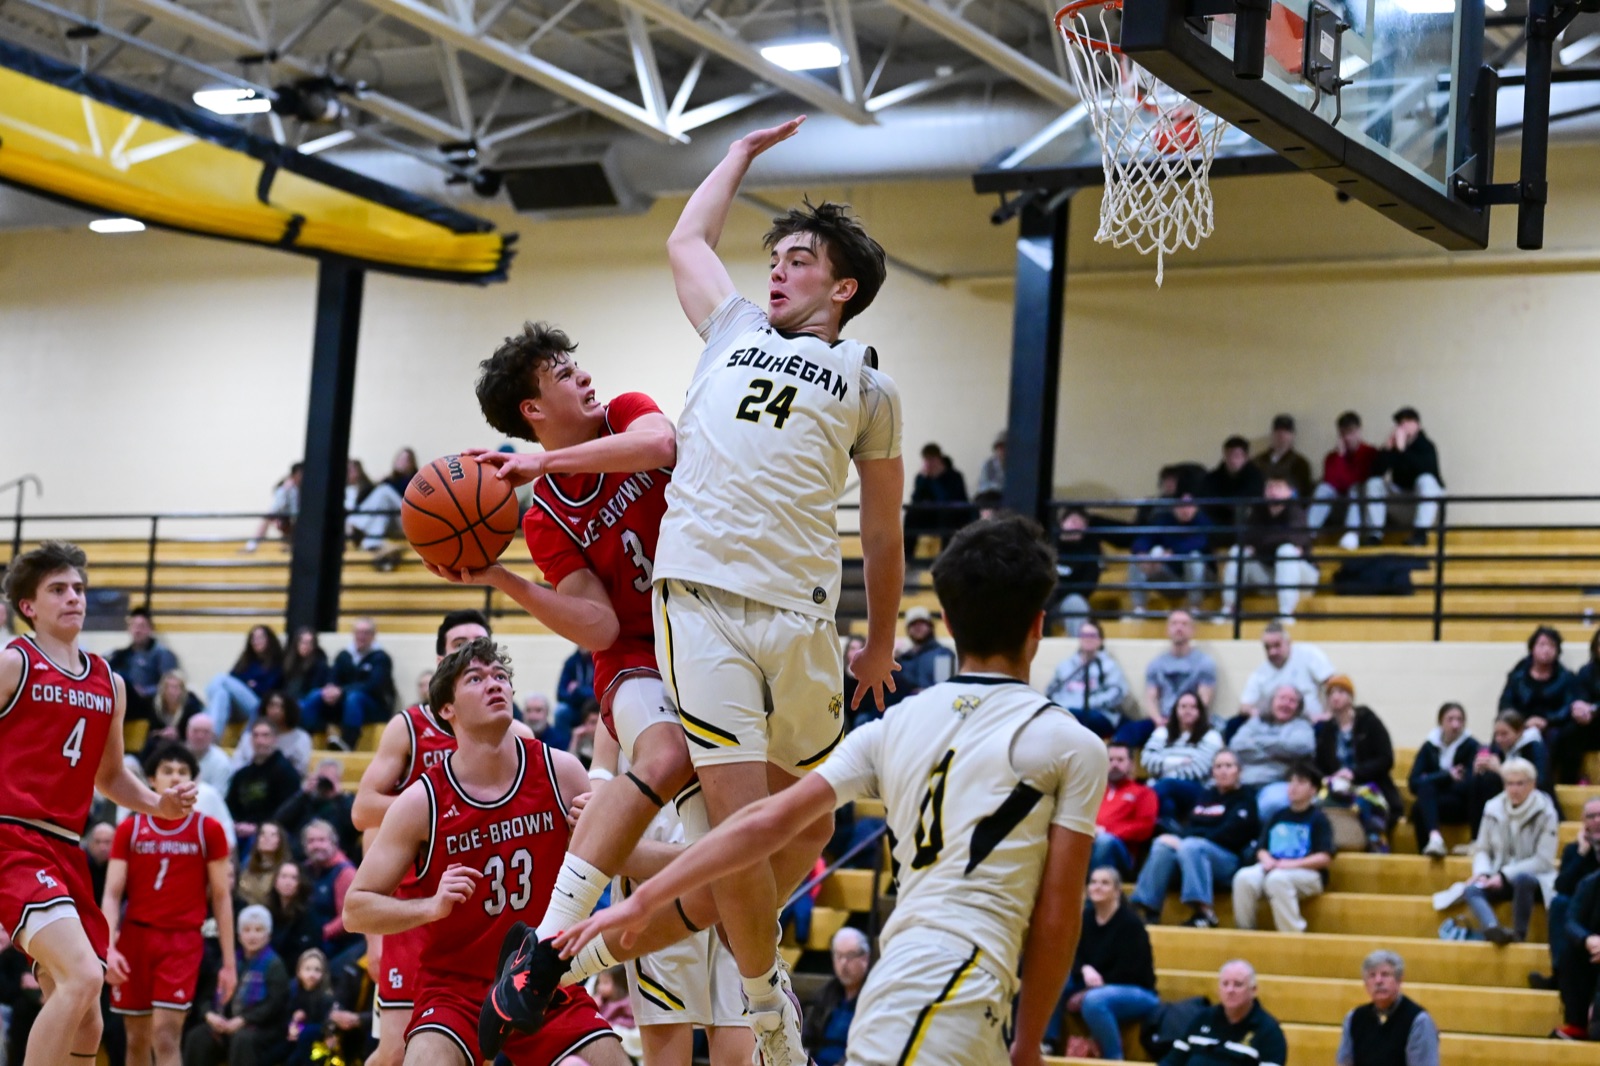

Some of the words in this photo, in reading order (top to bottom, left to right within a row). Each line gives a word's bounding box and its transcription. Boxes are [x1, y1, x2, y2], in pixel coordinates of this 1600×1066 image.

[726, 347, 848, 402] SOUHEGAN
[735, 378, 798, 430] 24
[581, 470, 654, 549] OE-BROWN
[620, 528, 654, 594] 3
[31, 683, 113, 715] COE-BROWN
[62, 716, 87, 768] 4
[446, 811, 555, 855] COE-BROWN
[153, 857, 170, 891] 1
[483, 848, 533, 916] 33
